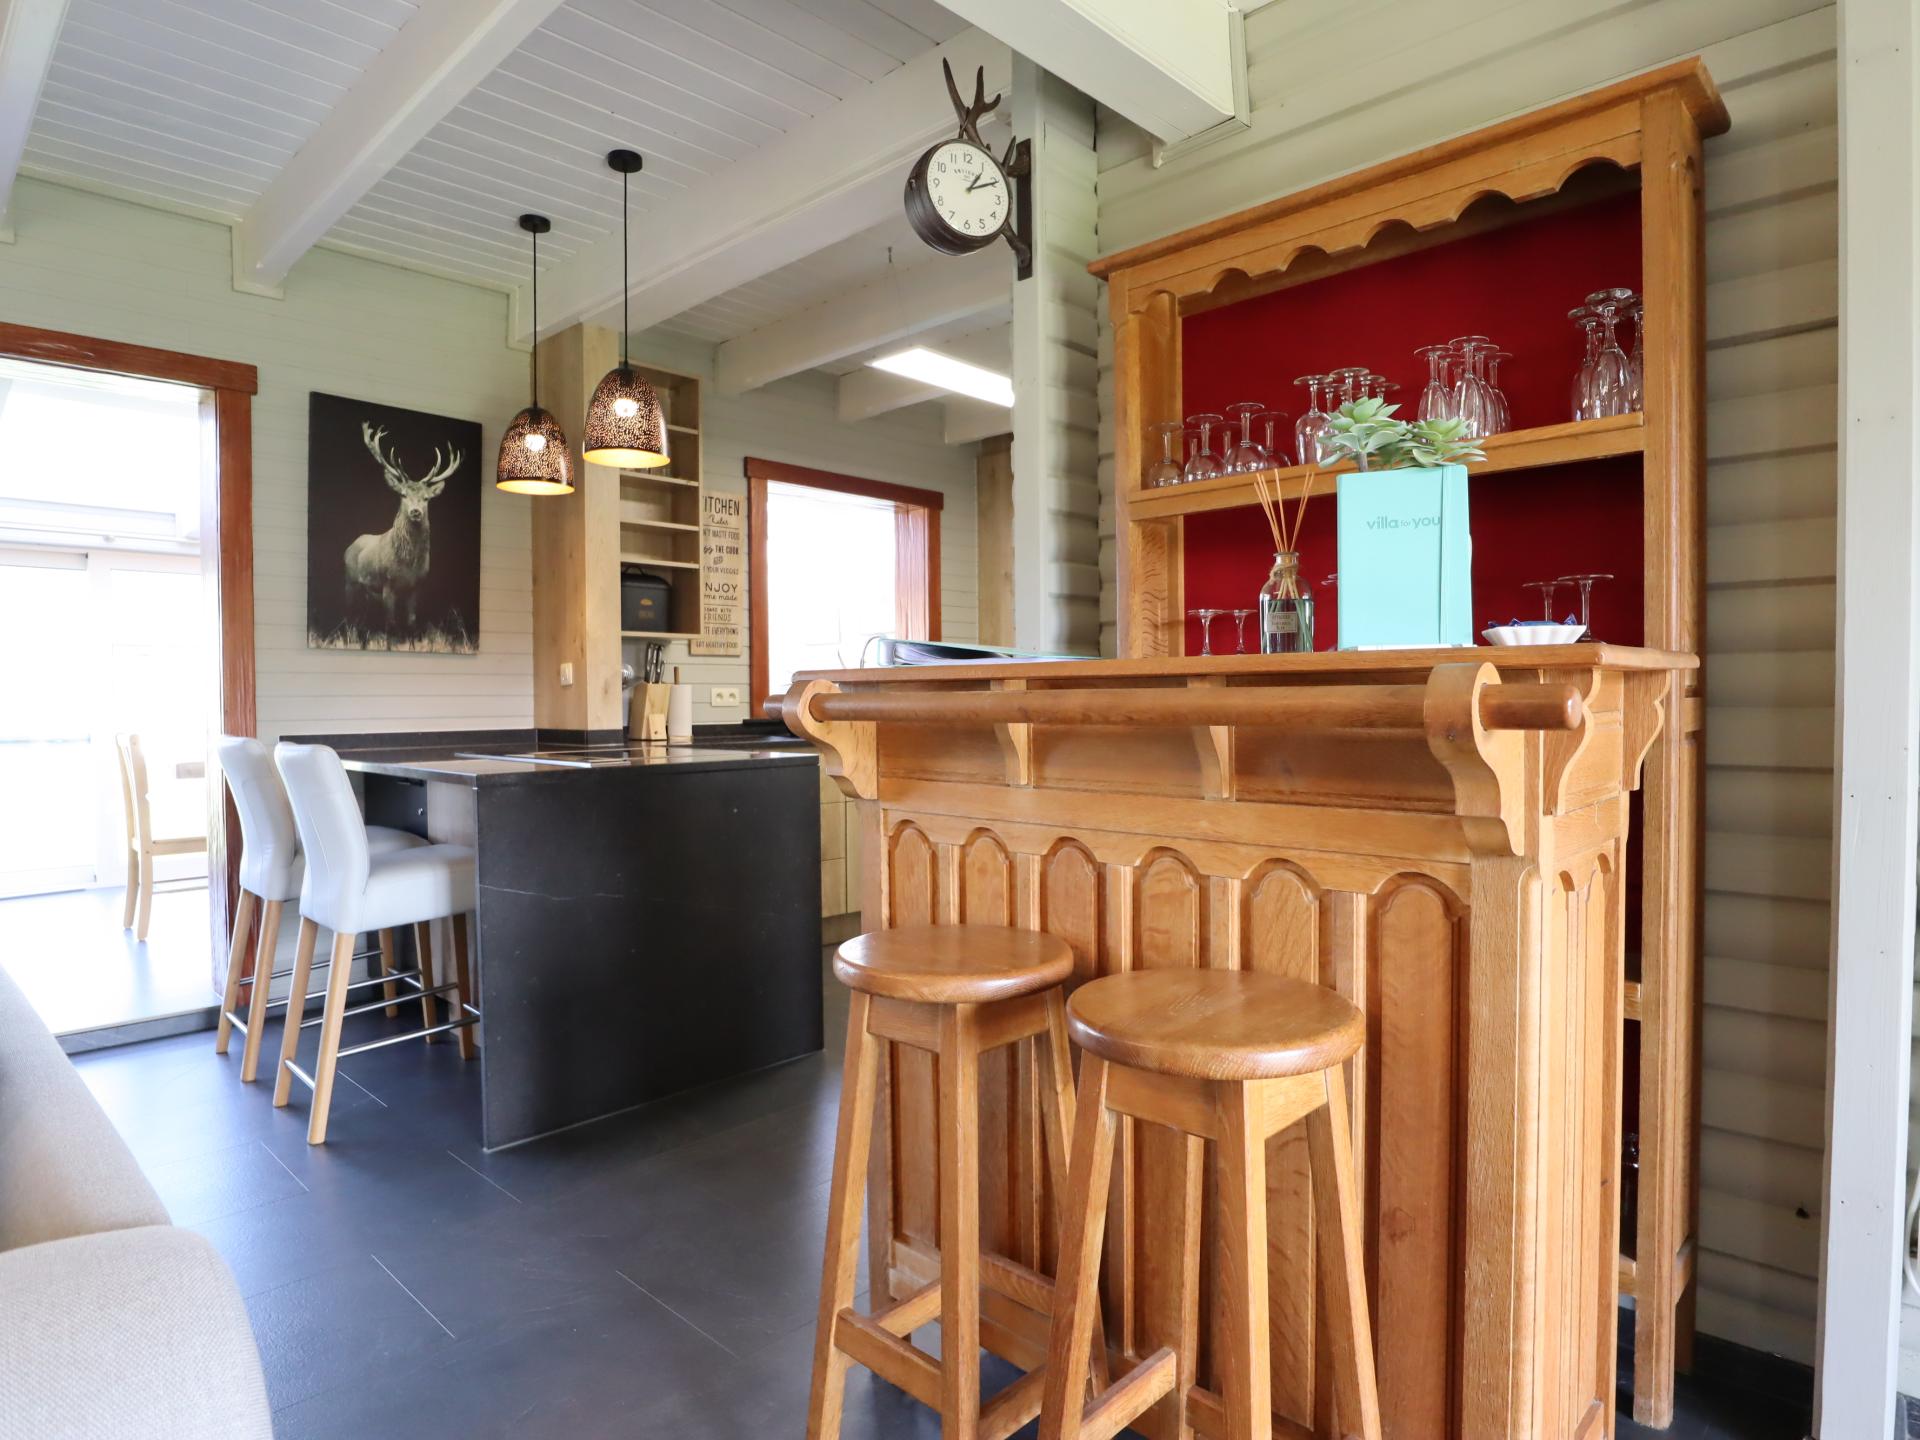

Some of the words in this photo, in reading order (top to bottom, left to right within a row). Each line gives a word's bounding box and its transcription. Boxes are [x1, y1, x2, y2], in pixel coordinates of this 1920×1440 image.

[950, 152, 957, 164] 11
[963, 152, 973, 164] 12
[937, 161, 947, 173] 10
[933, 177, 940, 188] 9
[937, 195, 944, 206] 8
[994, 194, 1002, 206] 3
[948, 210, 955, 220] 7
[990, 211, 997, 220] 4
[963, 220, 971, 230] 6
[979, 218, 986, 229] 5
[703, 496, 740, 516] ITCHEN
[1366, 516, 1399, 530] villa
[1412, 516, 1441, 529] you
[715, 545, 724, 554] THE
[705, 582, 738, 593] NJOY
